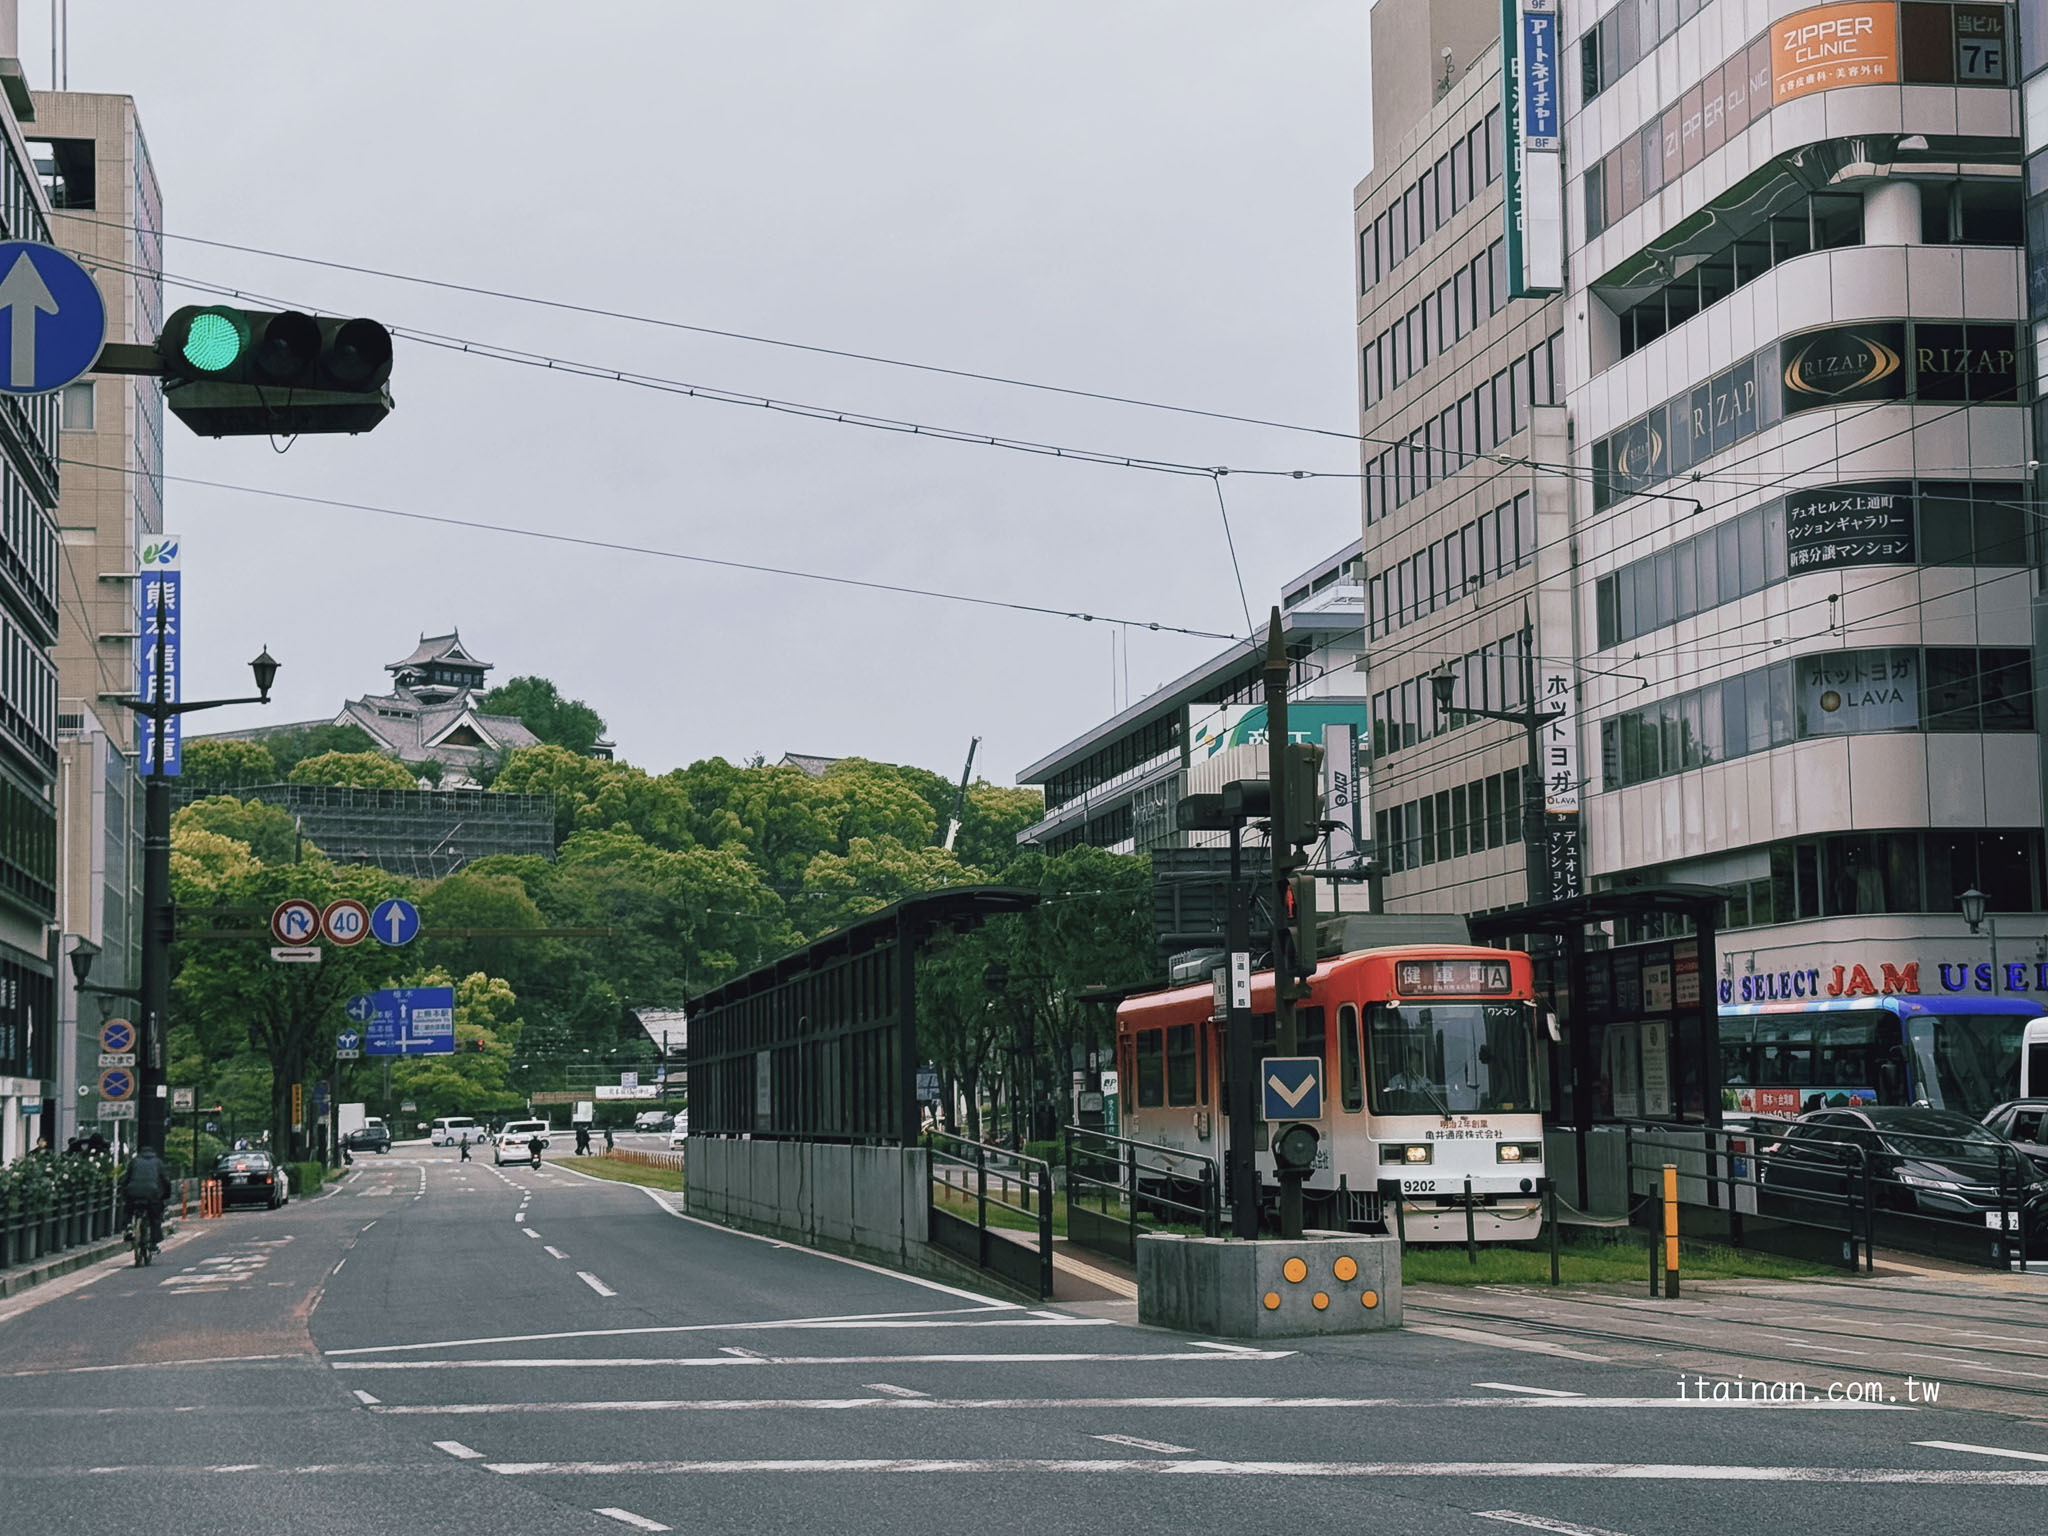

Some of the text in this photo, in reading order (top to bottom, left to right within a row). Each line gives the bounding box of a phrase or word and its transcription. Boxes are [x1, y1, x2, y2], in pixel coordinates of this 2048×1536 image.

[1783, 16, 1873, 50] ZIPPER
[1958, 15, 2003, 32] 当ビル
[1796, 39, 1857, 63] CLINIC
[1963, 45, 2000, 74] 7F
[1530, 19, 1550, 132] アートネイチャー
[1665, 68, 1768, 157] ZIPPER CLINIC
[1535, 138, 1549, 147] 8F
[1804, 353, 1868, 377] RIZAP
[1918, 348, 2015, 375] RIZAP
[1693, 380, 1755, 440] RIZAP
[1792, 496, 1895, 521] デュオヒルズ上通町
[1788, 514, 1905, 540] マンションギャラリー
[1790, 541, 1909, 568] 新築分譲マンション
[1812, 658, 1910, 686] ホットヨガ
[1848, 688, 1904, 707] LAVA
[1547, 675, 1572, 791] ホットヨガ
[333, 912, 359, 933] 40
[1402, 966, 1486, 985] 健軍町
[1491, 968, 1505, 986] A
[1741, 967, 1820, 1001] SELECT
[1827, 961, 1920, 995] JAM
[1488, 1008, 1517, 1016] ワンマン
[1440, 1119, 1488, 1128] 明治2年創業
[1404, 1180, 1436, 1192] 9202
